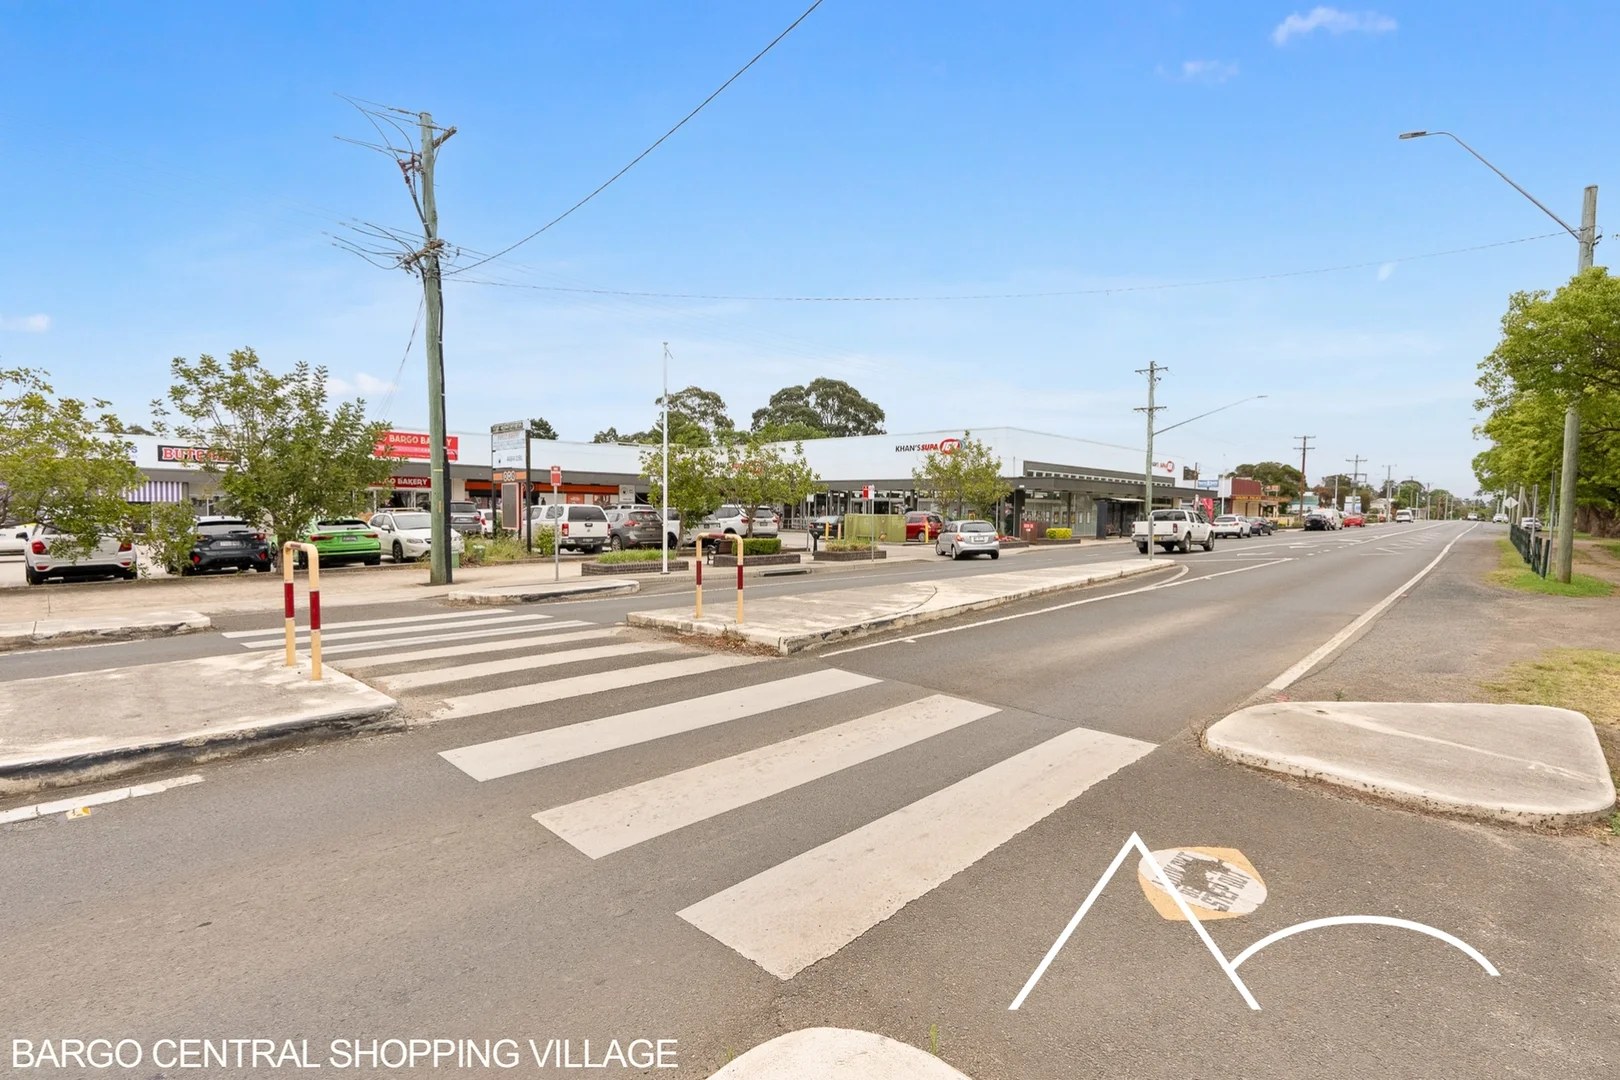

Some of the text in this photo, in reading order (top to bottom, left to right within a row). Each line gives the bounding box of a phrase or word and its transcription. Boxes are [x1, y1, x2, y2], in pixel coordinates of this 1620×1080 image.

[389, 434, 452, 446] BARGO BAY
[895, 444, 920, 452] KHAN'S
[921, 443, 938, 451] SUPA
[397, 477, 428, 486] BAKERY
